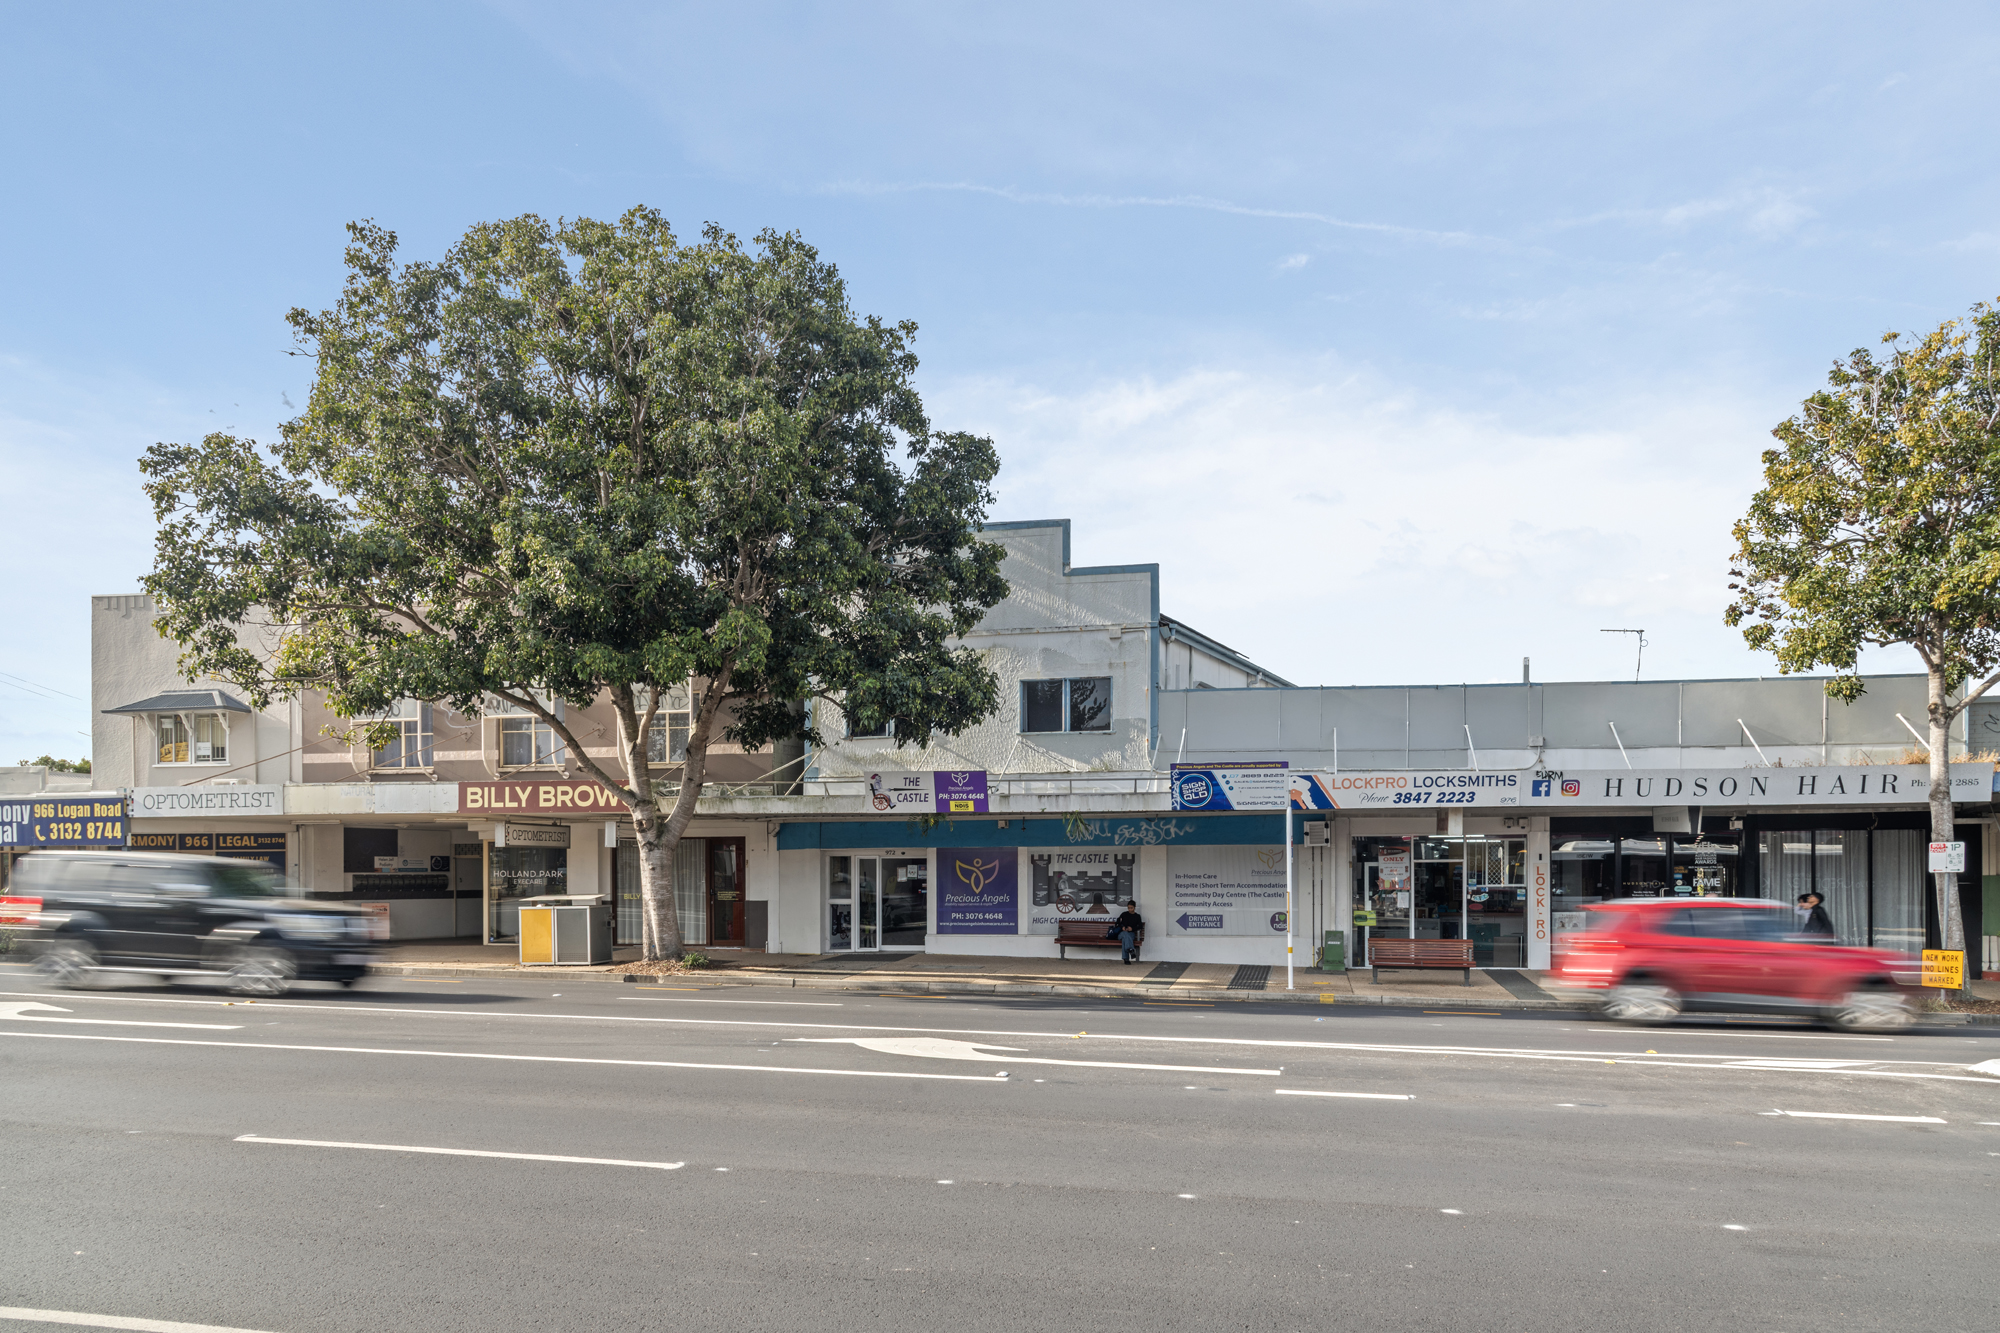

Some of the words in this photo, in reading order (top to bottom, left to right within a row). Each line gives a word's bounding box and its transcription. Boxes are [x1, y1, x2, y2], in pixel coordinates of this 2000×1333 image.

[903, 777, 920, 787] THE
[1182, 781, 1206, 789] SIGN
[1332, 777, 1408, 790] LOCKPRO
[1413, 775, 1517, 788] LOCKSMITHS
[1603, 776, 1769, 797] HUDSON
[1797, 774, 1899, 795] HAIR
[1911, 779, 1926, 787] Ph:
[1955, 778, 1979, 786] 2885
[1183, 786, 1207, 794] SHOP
[1184, 791, 1208, 800] QLD
[143, 791, 275, 810] OPTOMETRIST
[466, 786, 532, 808] BILLY
[539, 785, 630, 808] BROW
[897, 793, 929, 803] CASTLE
[1358, 792, 1390, 804] Phone
[1393, 792, 1432, 804] 3847
[1436, 791, 1476, 803] 2223
[0, 804, 31, 825] ony
[34, 804, 55, 818] 966
[58, 804, 91, 819] Logan
[93, 803, 121, 817] Road
[0, 823, 17, 845] al
[50, 822, 82, 839] 3132
[86, 822, 122, 839] 8744
[512, 829, 567, 842] OPTOMETRIST
[131, 835, 175, 847] RMONY
[185, 836, 209, 847] 966
[219, 835, 257, 847] LEGAL
[1950, 843, 1961, 851] 1P
[1056, 854, 1073, 863] THE
[1075, 854, 1109, 863] CASTLE
[493, 870, 537, 878] HOLLAND
[540, 870, 563, 878] PARK
[1273, 869, 1287, 877] Ange
[1692, 878, 1721, 886] FAME
[945, 893, 980, 902] Precious
[981, 893, 1010, 904] Angels
[1536, 866, 1546, 939] LOCKRO
[1942, 954, 1959, 962] WORK
[1928, 976, 1954, 984] MARKED
